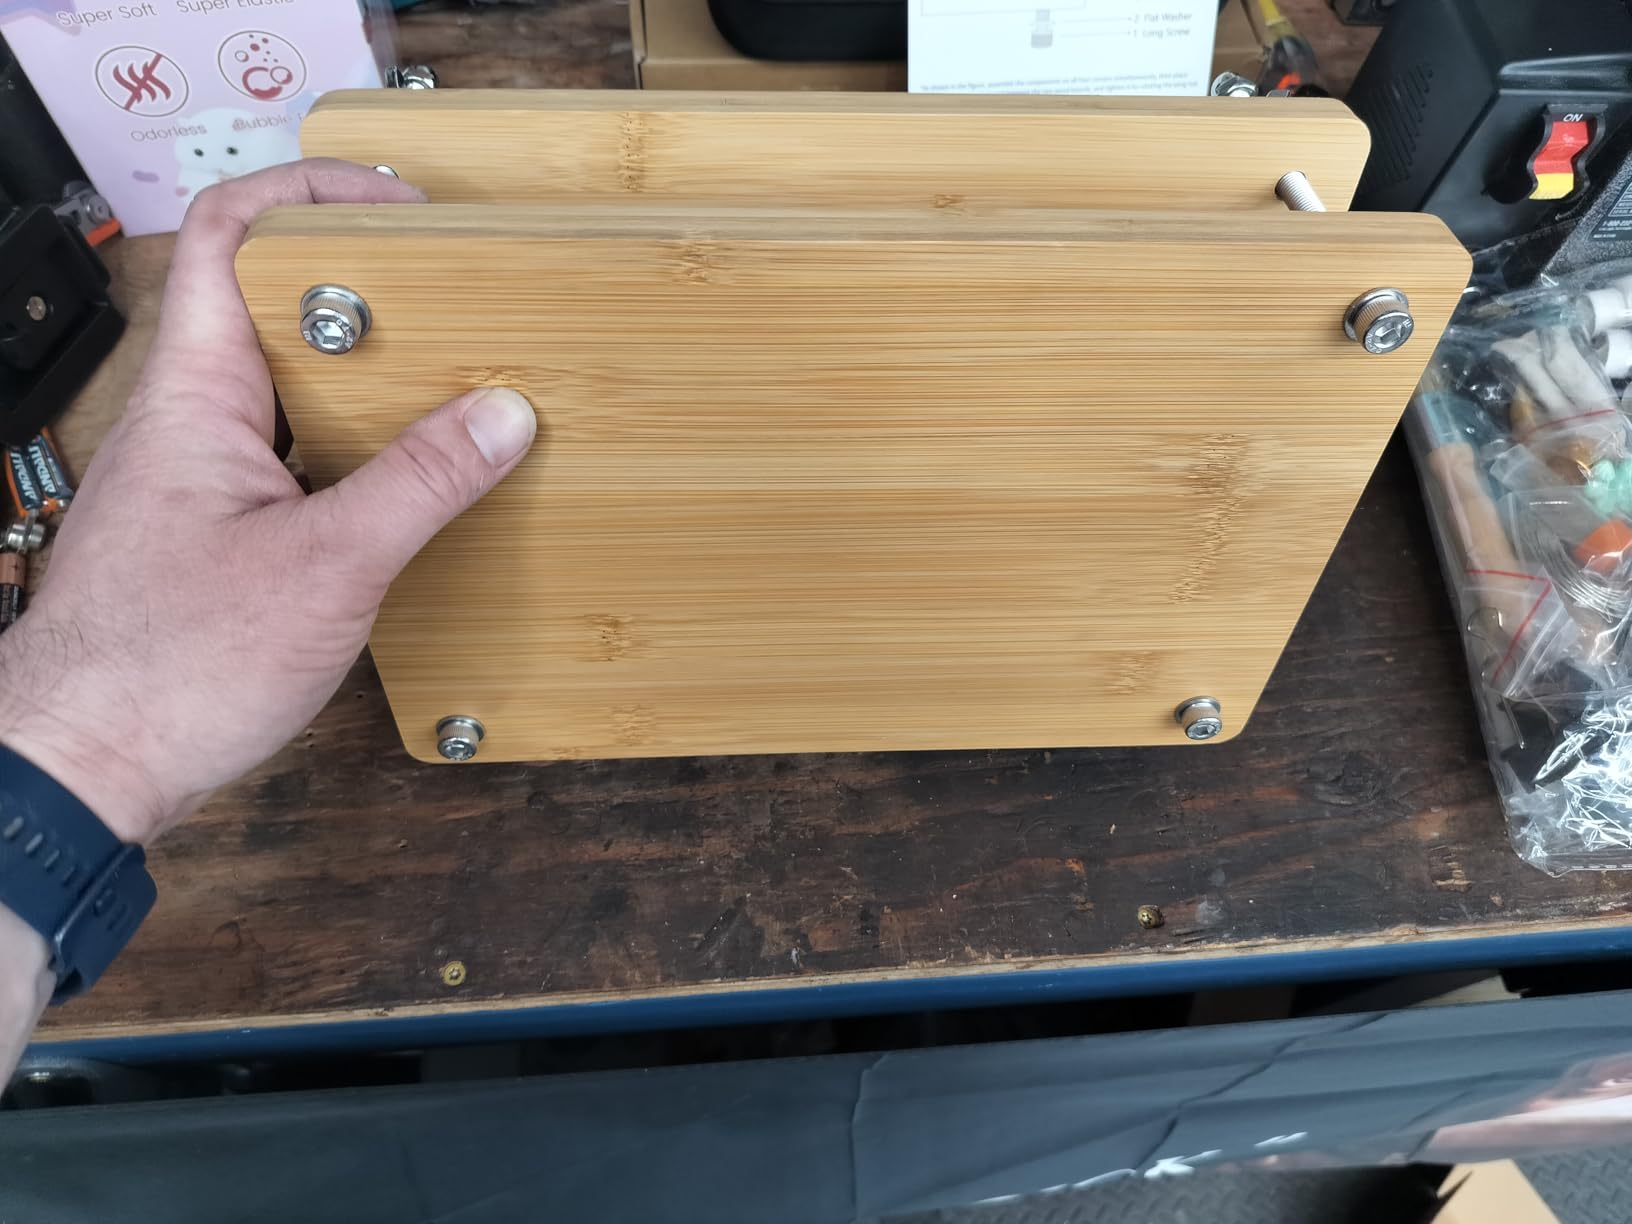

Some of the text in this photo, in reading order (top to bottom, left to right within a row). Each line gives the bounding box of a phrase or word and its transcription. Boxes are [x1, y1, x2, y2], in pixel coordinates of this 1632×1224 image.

[57, 4, 158, 27] Super Soft
[177, 0, 296, 15] Super Elas
[1562, 113, 1584, 122] ON
[130, 124, 208, 142] Odorless
